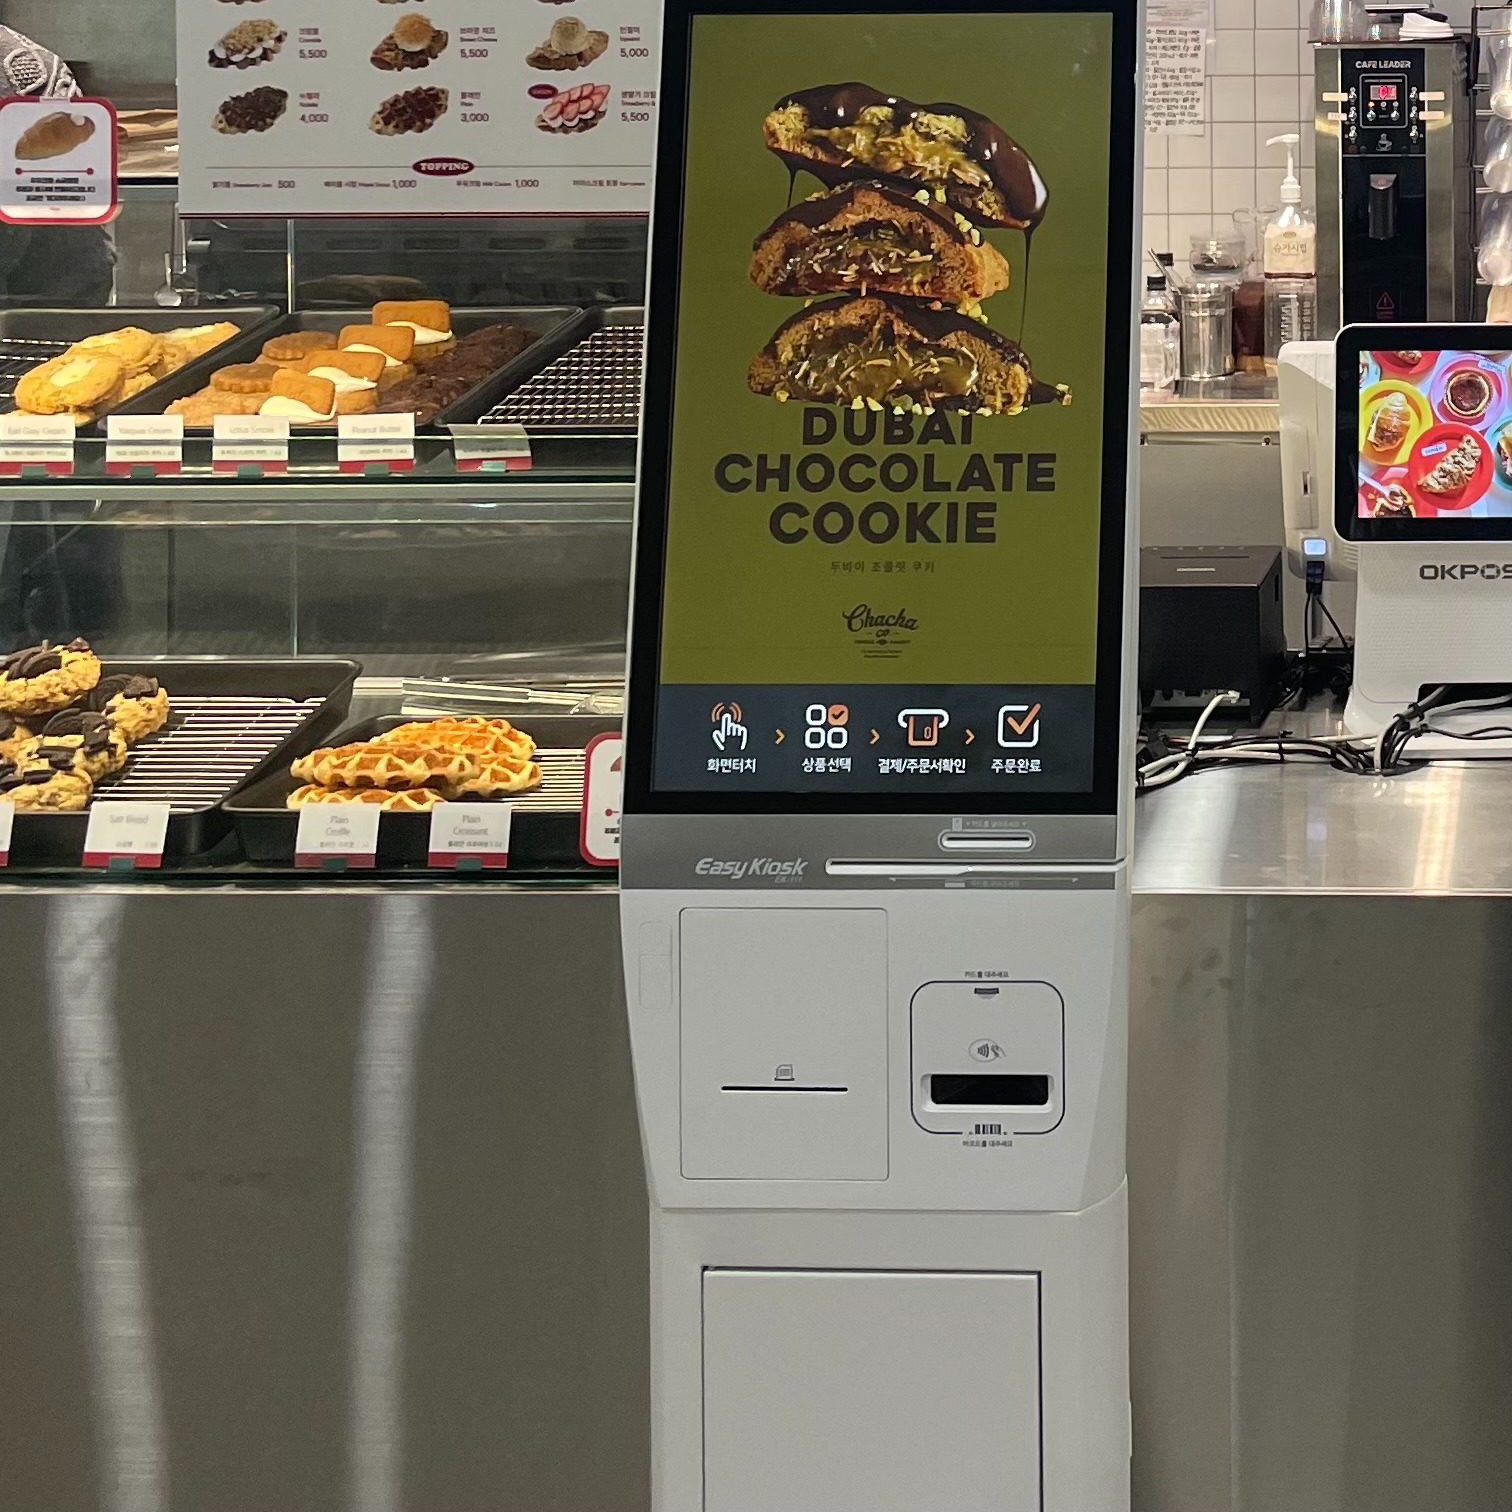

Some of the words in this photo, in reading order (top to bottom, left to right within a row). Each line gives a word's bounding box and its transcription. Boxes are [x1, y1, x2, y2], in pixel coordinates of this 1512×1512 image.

[300, 50, 328, 59] 5,500
[460, 48, 488, 58] 5,500
[620, 48, 649, 58] 5,000
[1356, 60, 1378, 69] CAFE
[1378, 60, 1411, 69] LEADER
[300, 114, 329, 123] 4,000
[460, 113, 490, 122] 3,000
[622, 112, 650, 122] 5,500
[420, 162, 470, 171] TOPPING
[278, 180, 295, 188] 500
[392, 180, 417, 189] 1,000
[514, 180, 540, 188] 1,000
[802, 406, 974, 446] DUBAI
[714, 453, 1057, 493] CHOCOLATE
[769, 501, 997, 544] COOKIE
[842, 604, 919, 632] Chacha
[706, 758, 757, 774] 화면터치
[802, 757, 852, 774] 상품선택
[878, 758, 967, 775] 결제/주문서확인
[990, 758, 1042, 774] 주문완료
[696, 858, 748, 879] Easy
[748, 858, 808, 876] Kiosk
